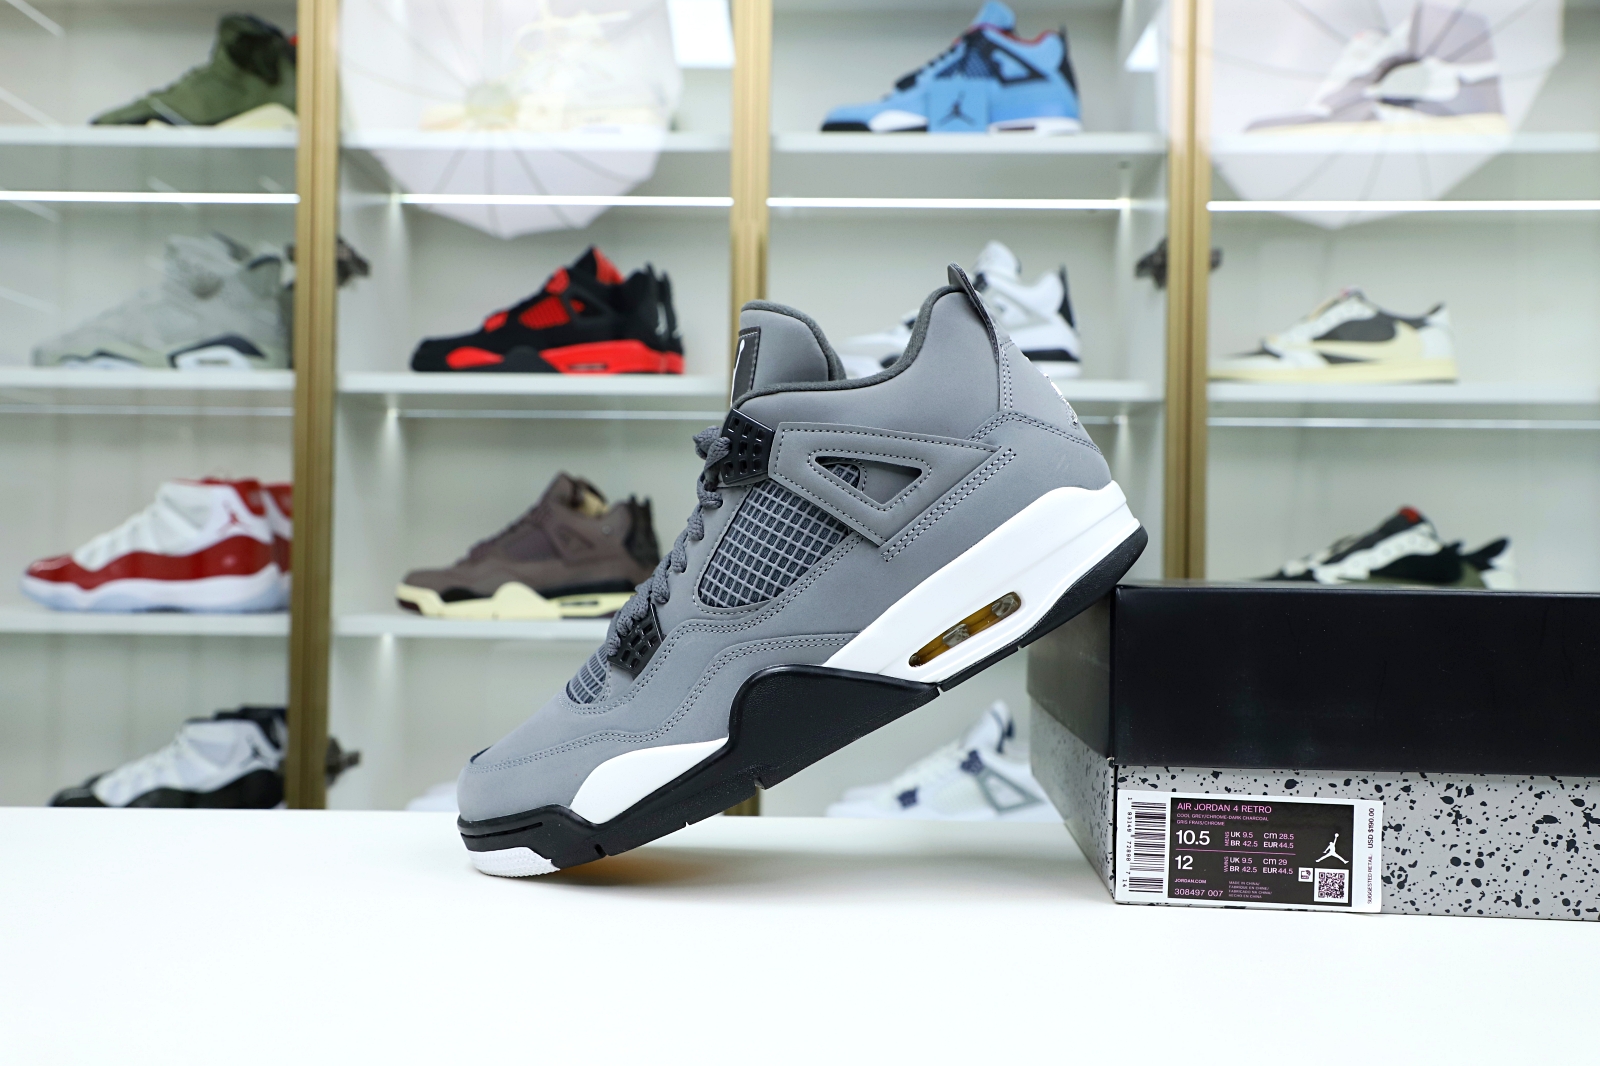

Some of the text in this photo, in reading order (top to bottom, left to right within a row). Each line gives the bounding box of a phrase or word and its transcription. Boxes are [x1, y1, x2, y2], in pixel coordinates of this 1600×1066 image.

[1177, 802, 1192, 810] AIR
[1194, 803, 1230, 812] JORDAN
[1242, 806, 1272, 814] RETRO
[1176, 830, 1210, 846] 10.5
[1174, 855, 1194, 870] 12
[1174, 888, 1205, 896] 308497
